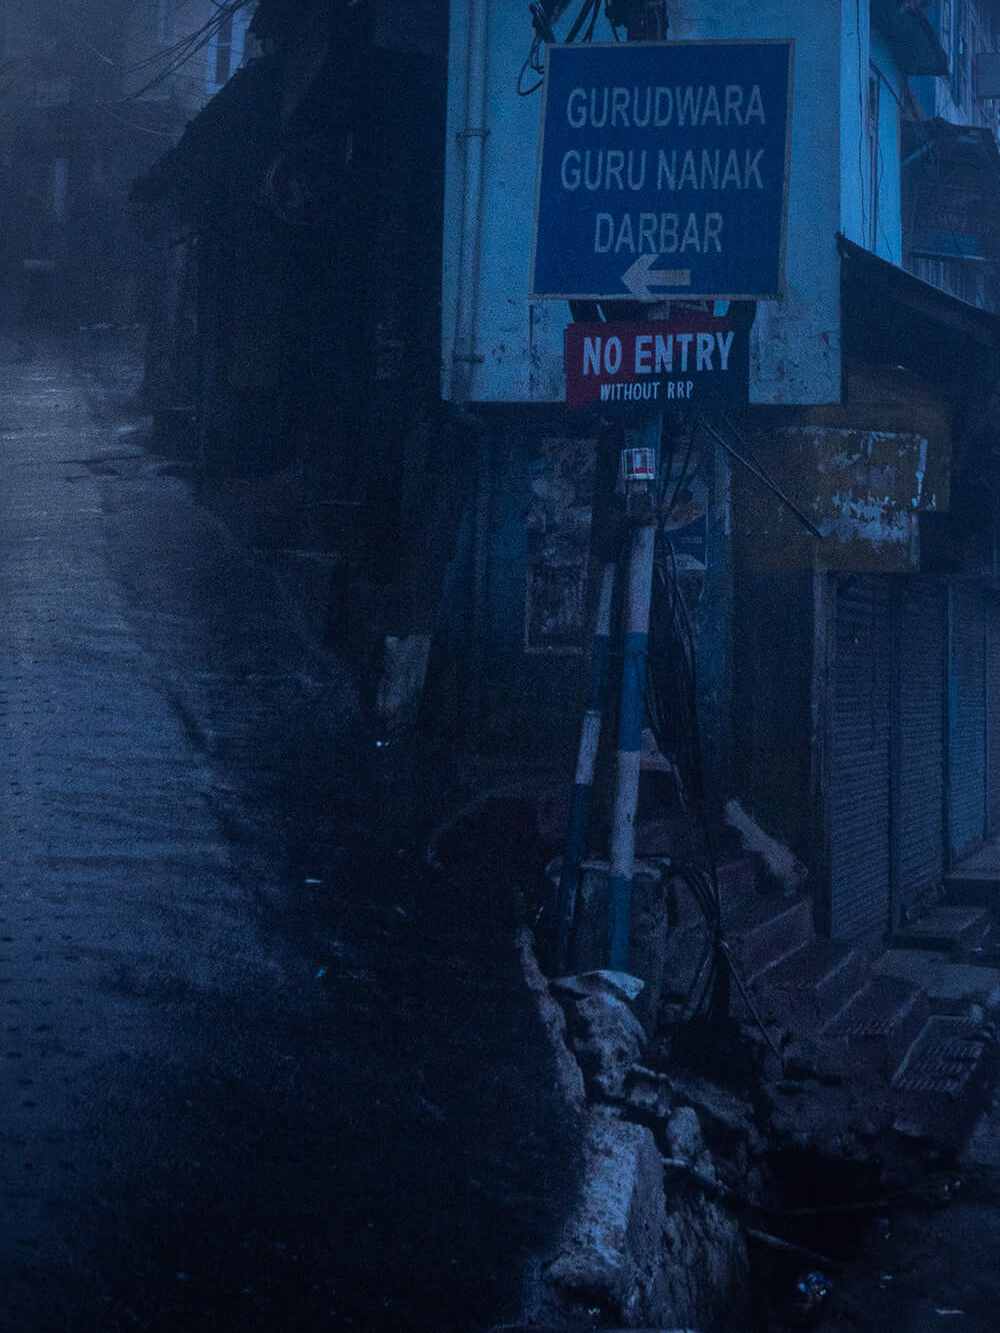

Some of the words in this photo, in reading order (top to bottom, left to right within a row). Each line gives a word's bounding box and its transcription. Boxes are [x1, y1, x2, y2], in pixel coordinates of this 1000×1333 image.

[566, 84, 766, 130] GURUDWARA
[560, 149, 646, 192] GURU
[656, 148, 765, 191] NANAK
[594, 212, 724, 254] DARBAR
[582, 334, 623, 377] NO
[634, 330, 735, 373] ENTRY
[599, 381, 660, 401] WITHOUT
[667, 380, 695, 400] RRP
